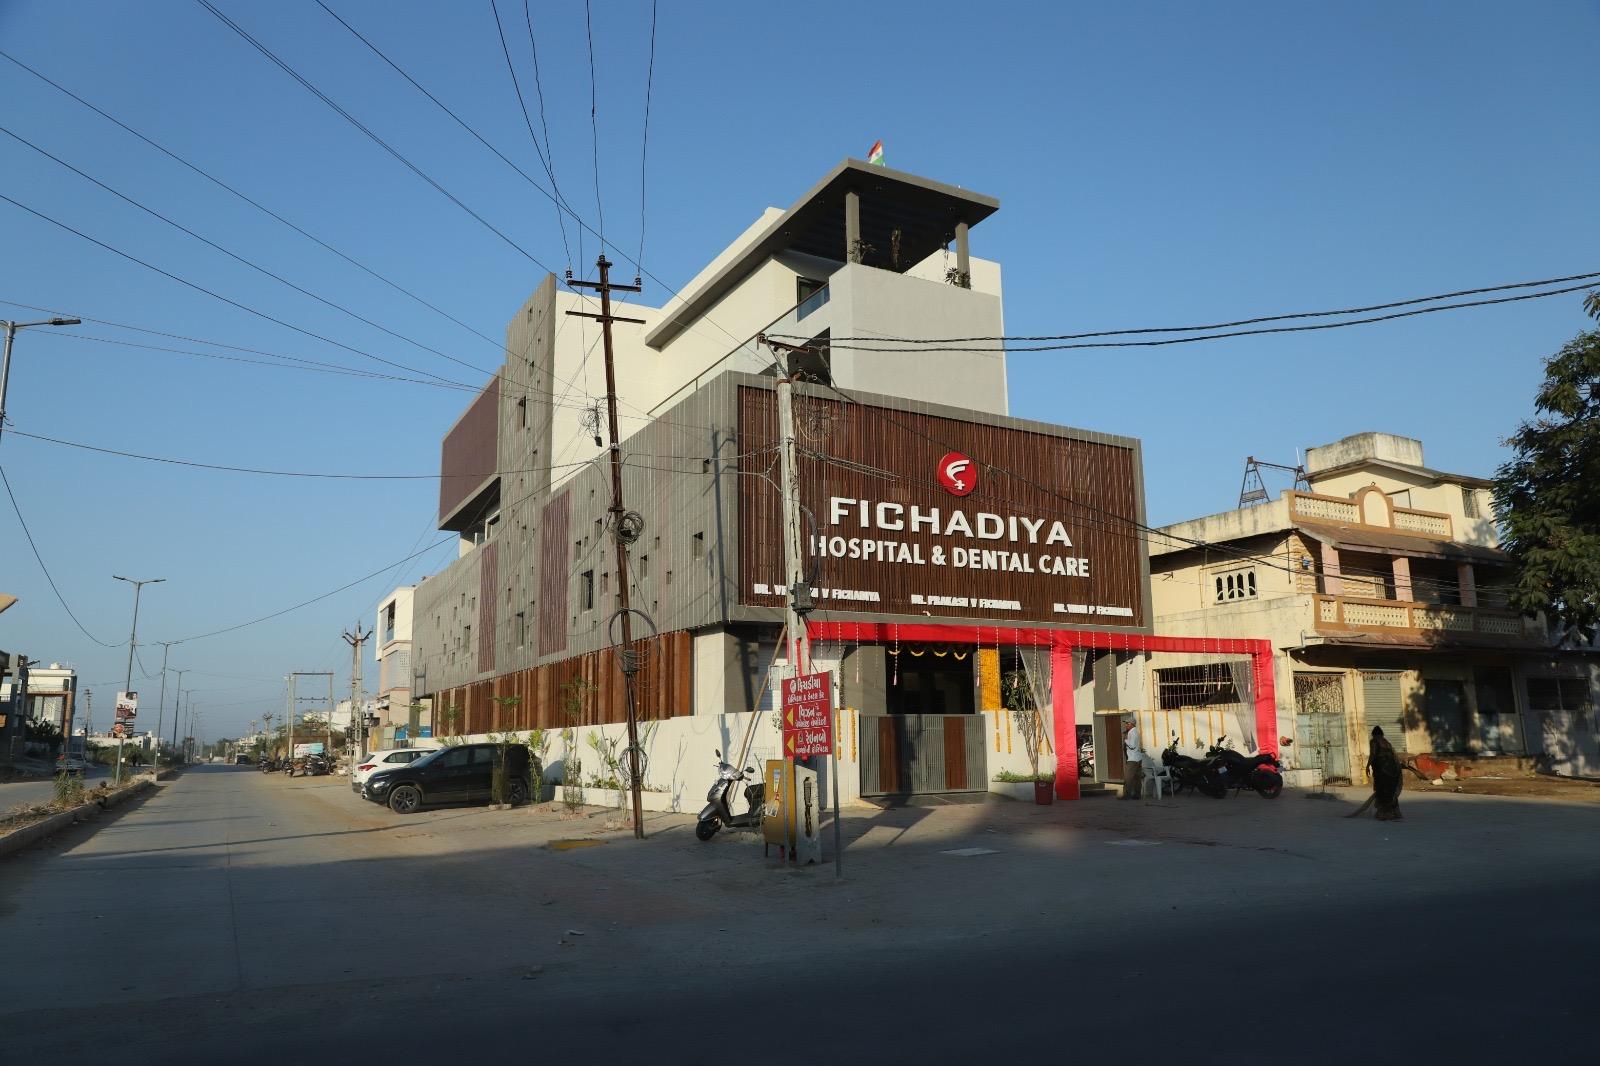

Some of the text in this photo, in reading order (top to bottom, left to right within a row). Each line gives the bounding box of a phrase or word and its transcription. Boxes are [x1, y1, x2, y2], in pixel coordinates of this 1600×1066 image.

[830, 496, 1073, 547] FICHADIYA
[811, 534, 1090, 577] HOSPITAL & DENTAL CARE
